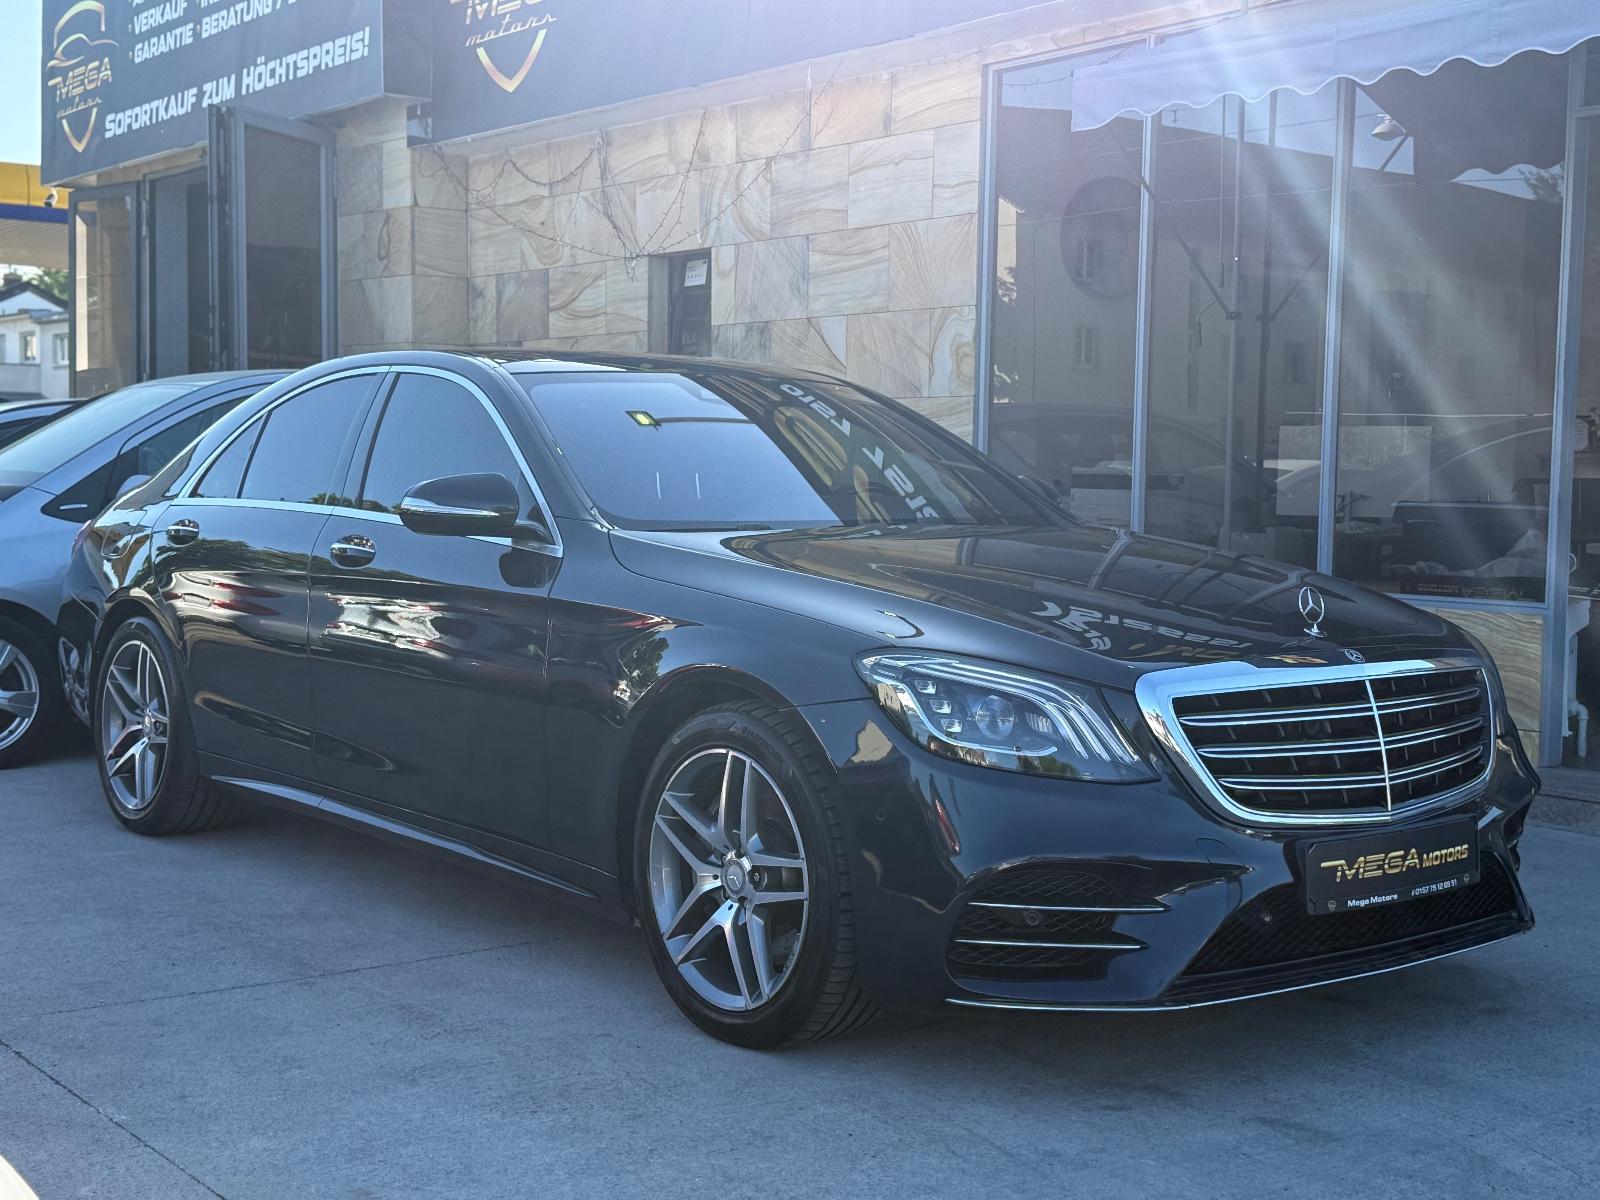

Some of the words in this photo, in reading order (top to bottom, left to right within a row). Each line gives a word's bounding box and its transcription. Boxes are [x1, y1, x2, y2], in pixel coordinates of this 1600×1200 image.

[134, 0, 188, 35] VERKAUF
[134, 22, 194, 64] GARANTIE
[201, 0, 273, 39] BERATUNG
[48, 57, 112, 103] MEGA
[104, 86, 198, 139] SOFORTKAUF
[202, 73, 236, 108] ZUM
[241, 26, 370, 96] HÖCHTSPREIS!
[1320, 848, 1420, 883] MEGA
[1422, 844, 1469, 868] MOTORS
[1347, 899, 1370, 908] Mega
[1370, 893, 1398, 904] Motors
